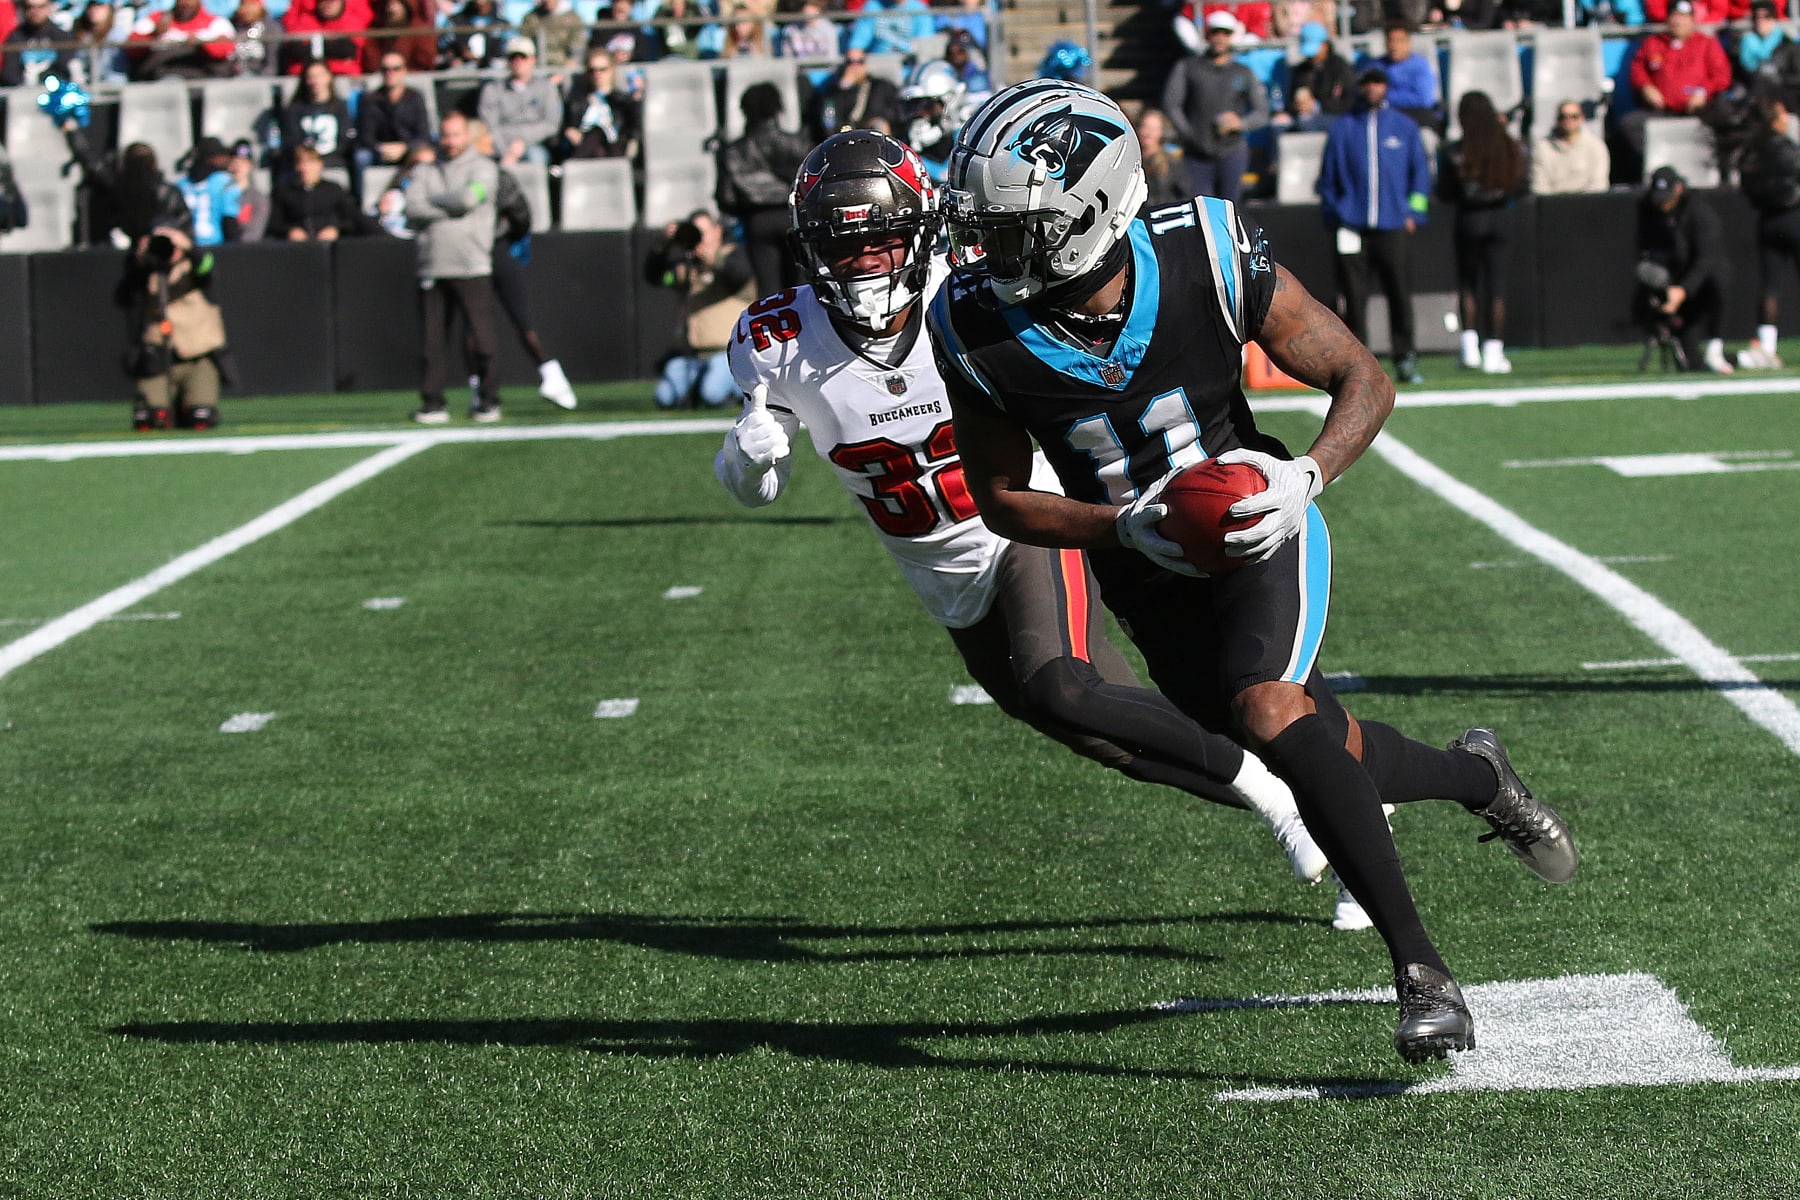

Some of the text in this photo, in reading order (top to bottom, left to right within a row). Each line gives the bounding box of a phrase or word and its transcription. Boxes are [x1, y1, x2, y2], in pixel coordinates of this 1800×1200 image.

[1150, 201, 1196, 235] 11
[748, 287, 803, 352] 32
[868, 400, 942, 426] BUCCANEERS
[1062, 386, 1208, 505] 11
